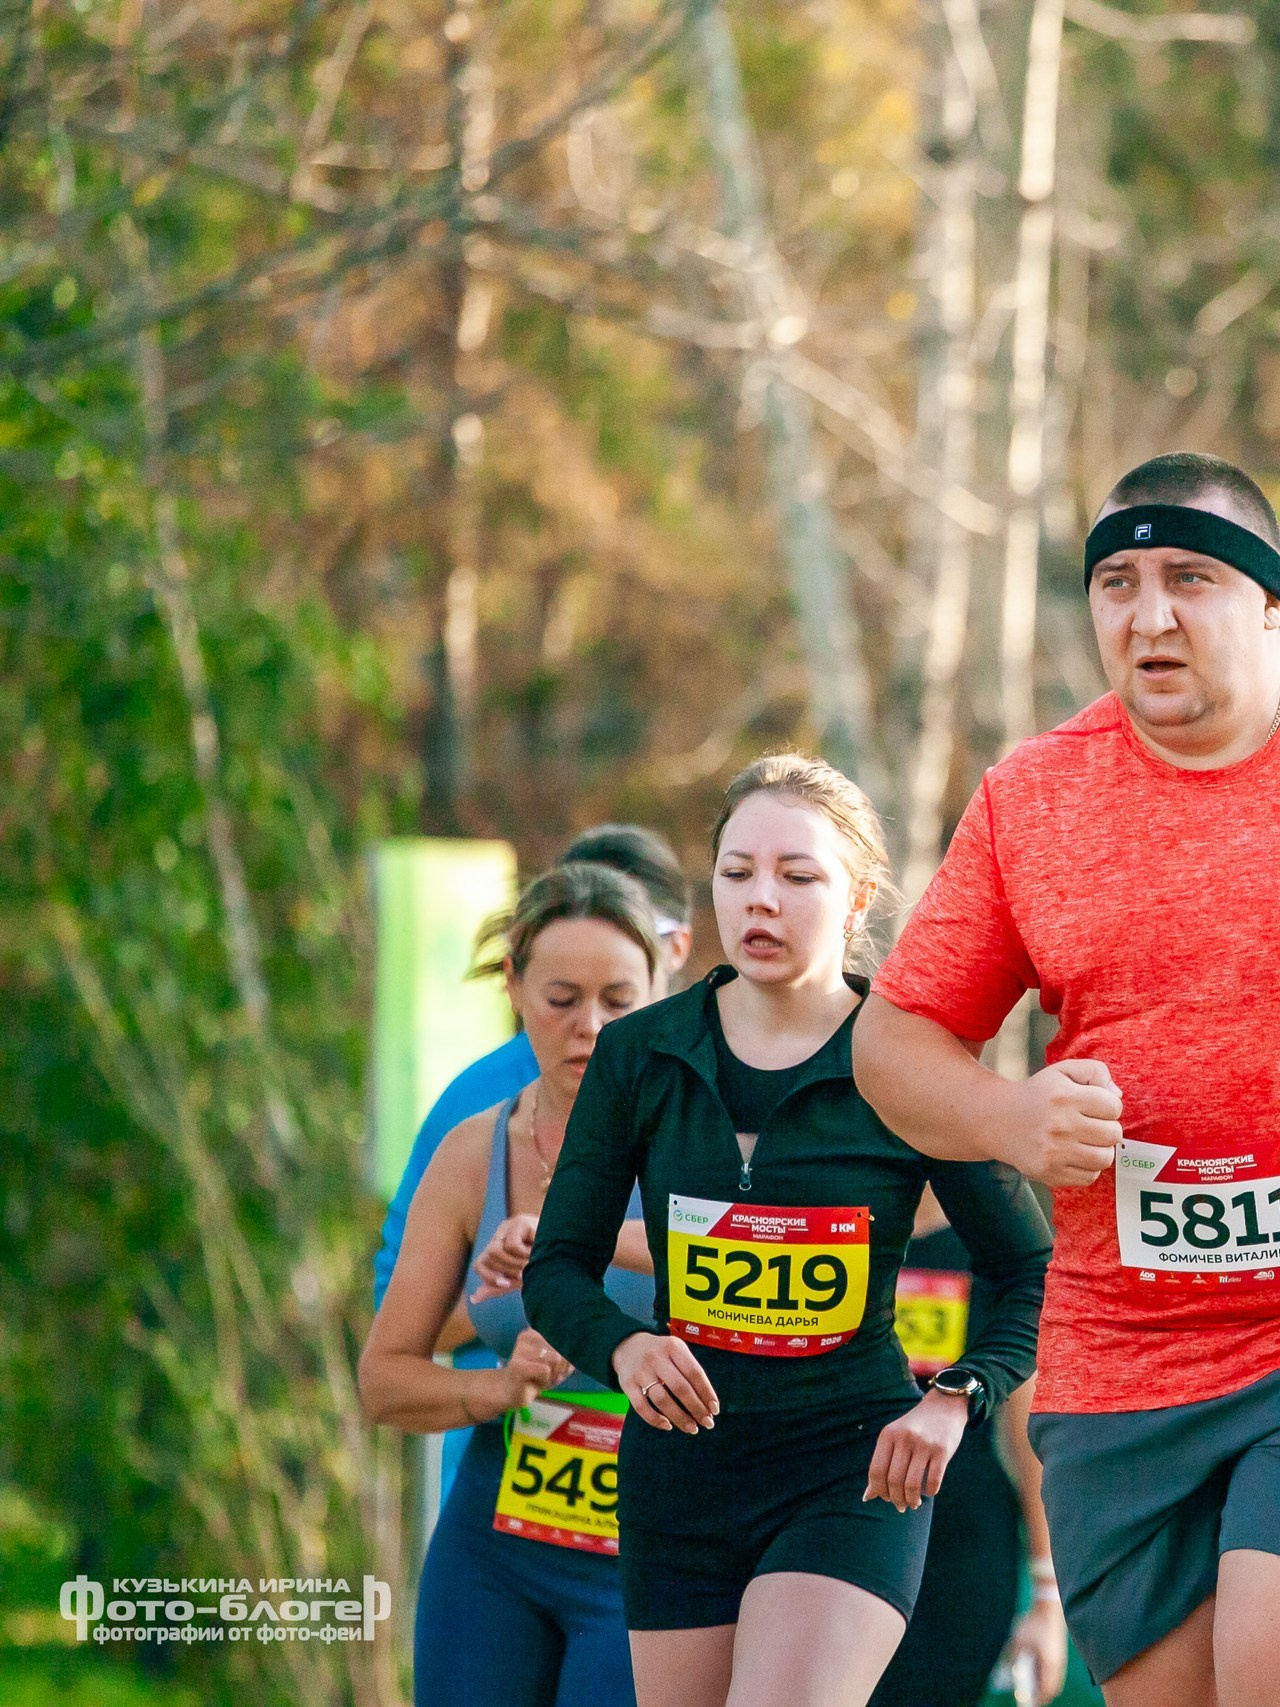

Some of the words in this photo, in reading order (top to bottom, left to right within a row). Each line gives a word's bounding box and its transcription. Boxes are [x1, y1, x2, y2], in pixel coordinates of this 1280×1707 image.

[1132, 1159, 1155, 1169] СБЕР
[1177, 1154, 1255, 1167] КРАСНОЯРСКИЕ
[1198, 1165, 1235, 1175] МОСТЫ
[684, 1213, 709, 1225] СБЕР
[731, 1213, 807, 1227] КРАСНОЯРСКИЕ
[751, 1225, 787, 1235] МОСТЫ
[830, 1223, 838, 1232] 5
[838, 1223, 856, 1233] КМ
[752, 1233, 784, 1241] МАРАФОН
[1158, 1251, 1223, 1264] ФОМИЧЕВ
[685, 1244, 848, 1312] 5219
[707, 1308, 772, 1326] МОНИЧЕВА
[775, 1316, 819, 1328] ДАРЬЯ
[820, 1335, 843, 1347] 2026
